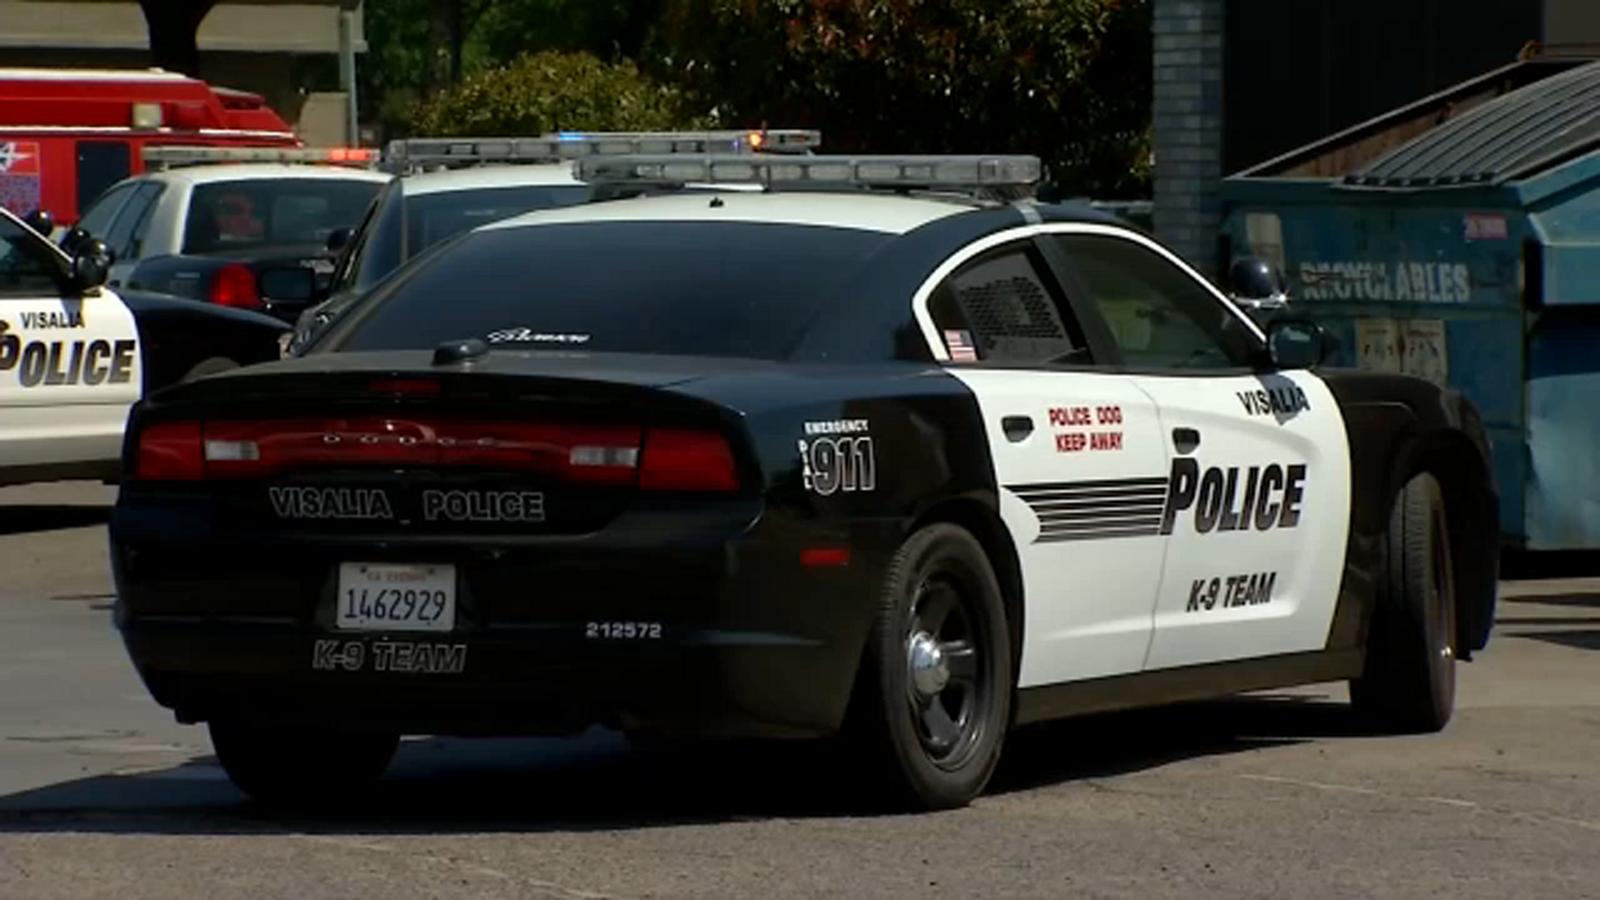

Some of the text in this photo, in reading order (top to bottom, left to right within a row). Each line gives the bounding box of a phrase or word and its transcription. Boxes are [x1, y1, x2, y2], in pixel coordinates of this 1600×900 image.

[20, 312, 85, 329] VISALIA
[1047, 406, 1122, 426] POLICE DOG
[1236, 386, 1311, 415] VISALIA
[804, 420, 869, 435] EMERGENCY
[1055, 432, 1123, 452] KEEP AWAY
[810, 437, 875, 495] 911
[269, 487, 546, 522] VISALIA POLICE
[1159, 456, 1307, 536] POLICE
[344, 588, 446, 622] 1462929
[1185, 571, 1277, 613] K-9 TEAM
[586, 621, 662, 639] 212572
[312, 640, 467, 673] K-9 TEAM
